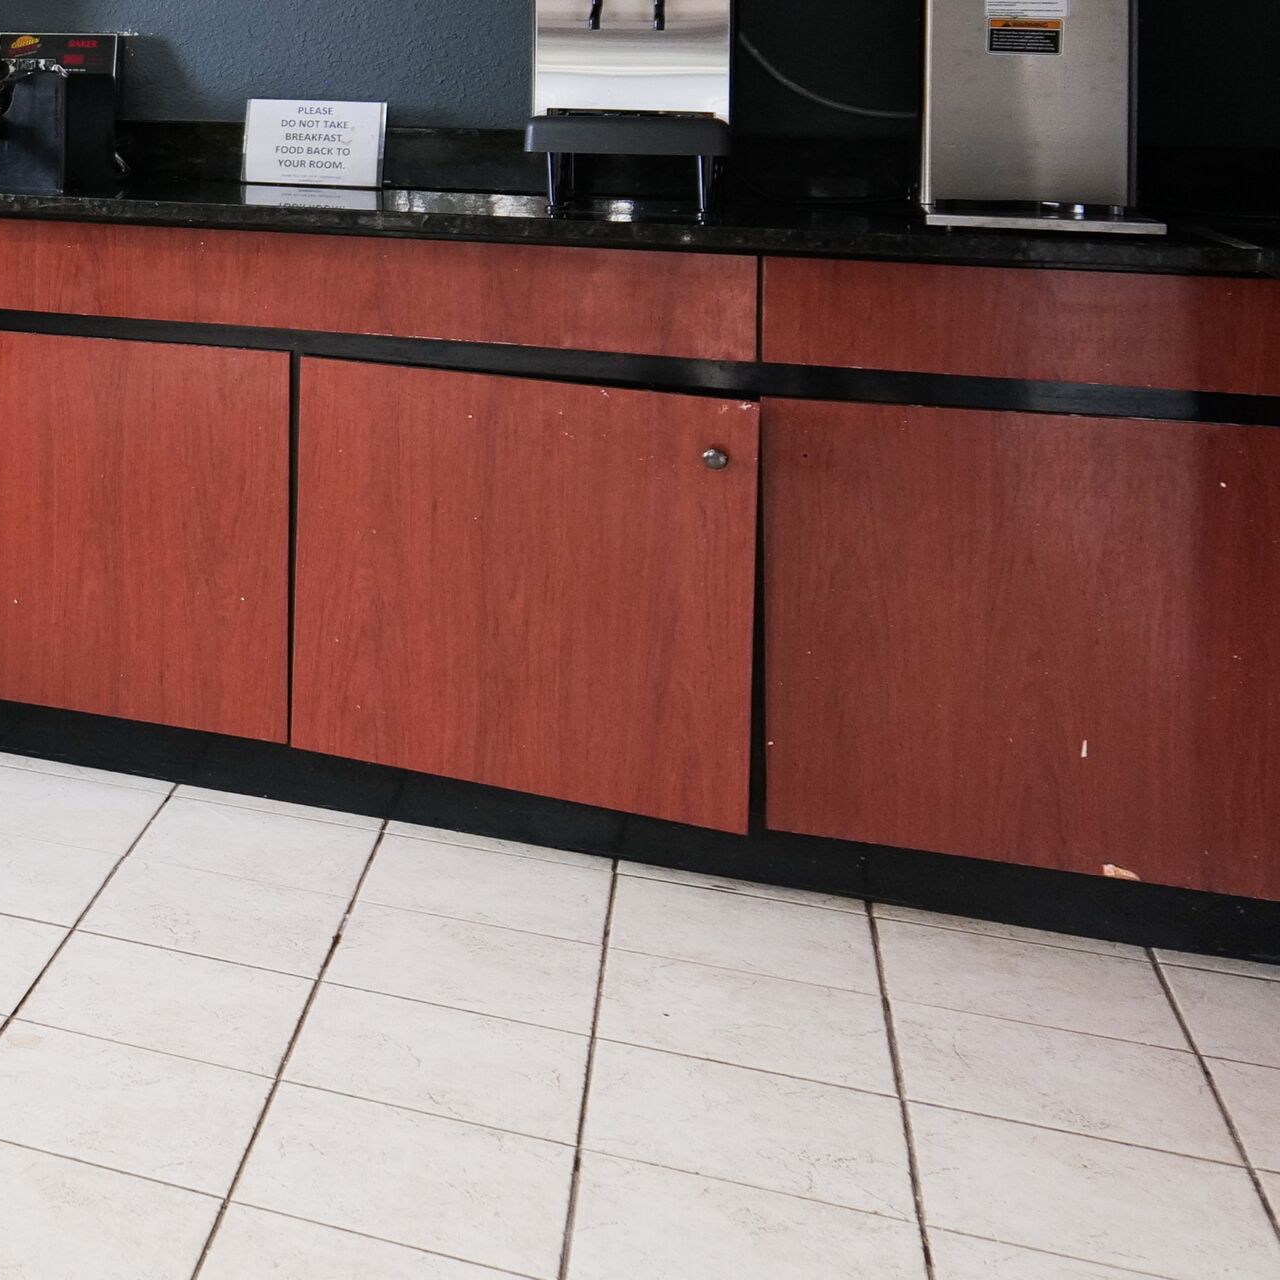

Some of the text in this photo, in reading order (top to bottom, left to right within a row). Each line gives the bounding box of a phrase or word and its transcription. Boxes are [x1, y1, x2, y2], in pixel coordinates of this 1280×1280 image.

[298, 106, 334, 115] PLEASE
[281, 120, 349, 129] DO NOT TAKE
[285, 133, 342, 142] BREAKFAST
[275, 145, 351, 156] FOOD BACK TO
[278, 159, 345, 169] YOUR ROOM.
